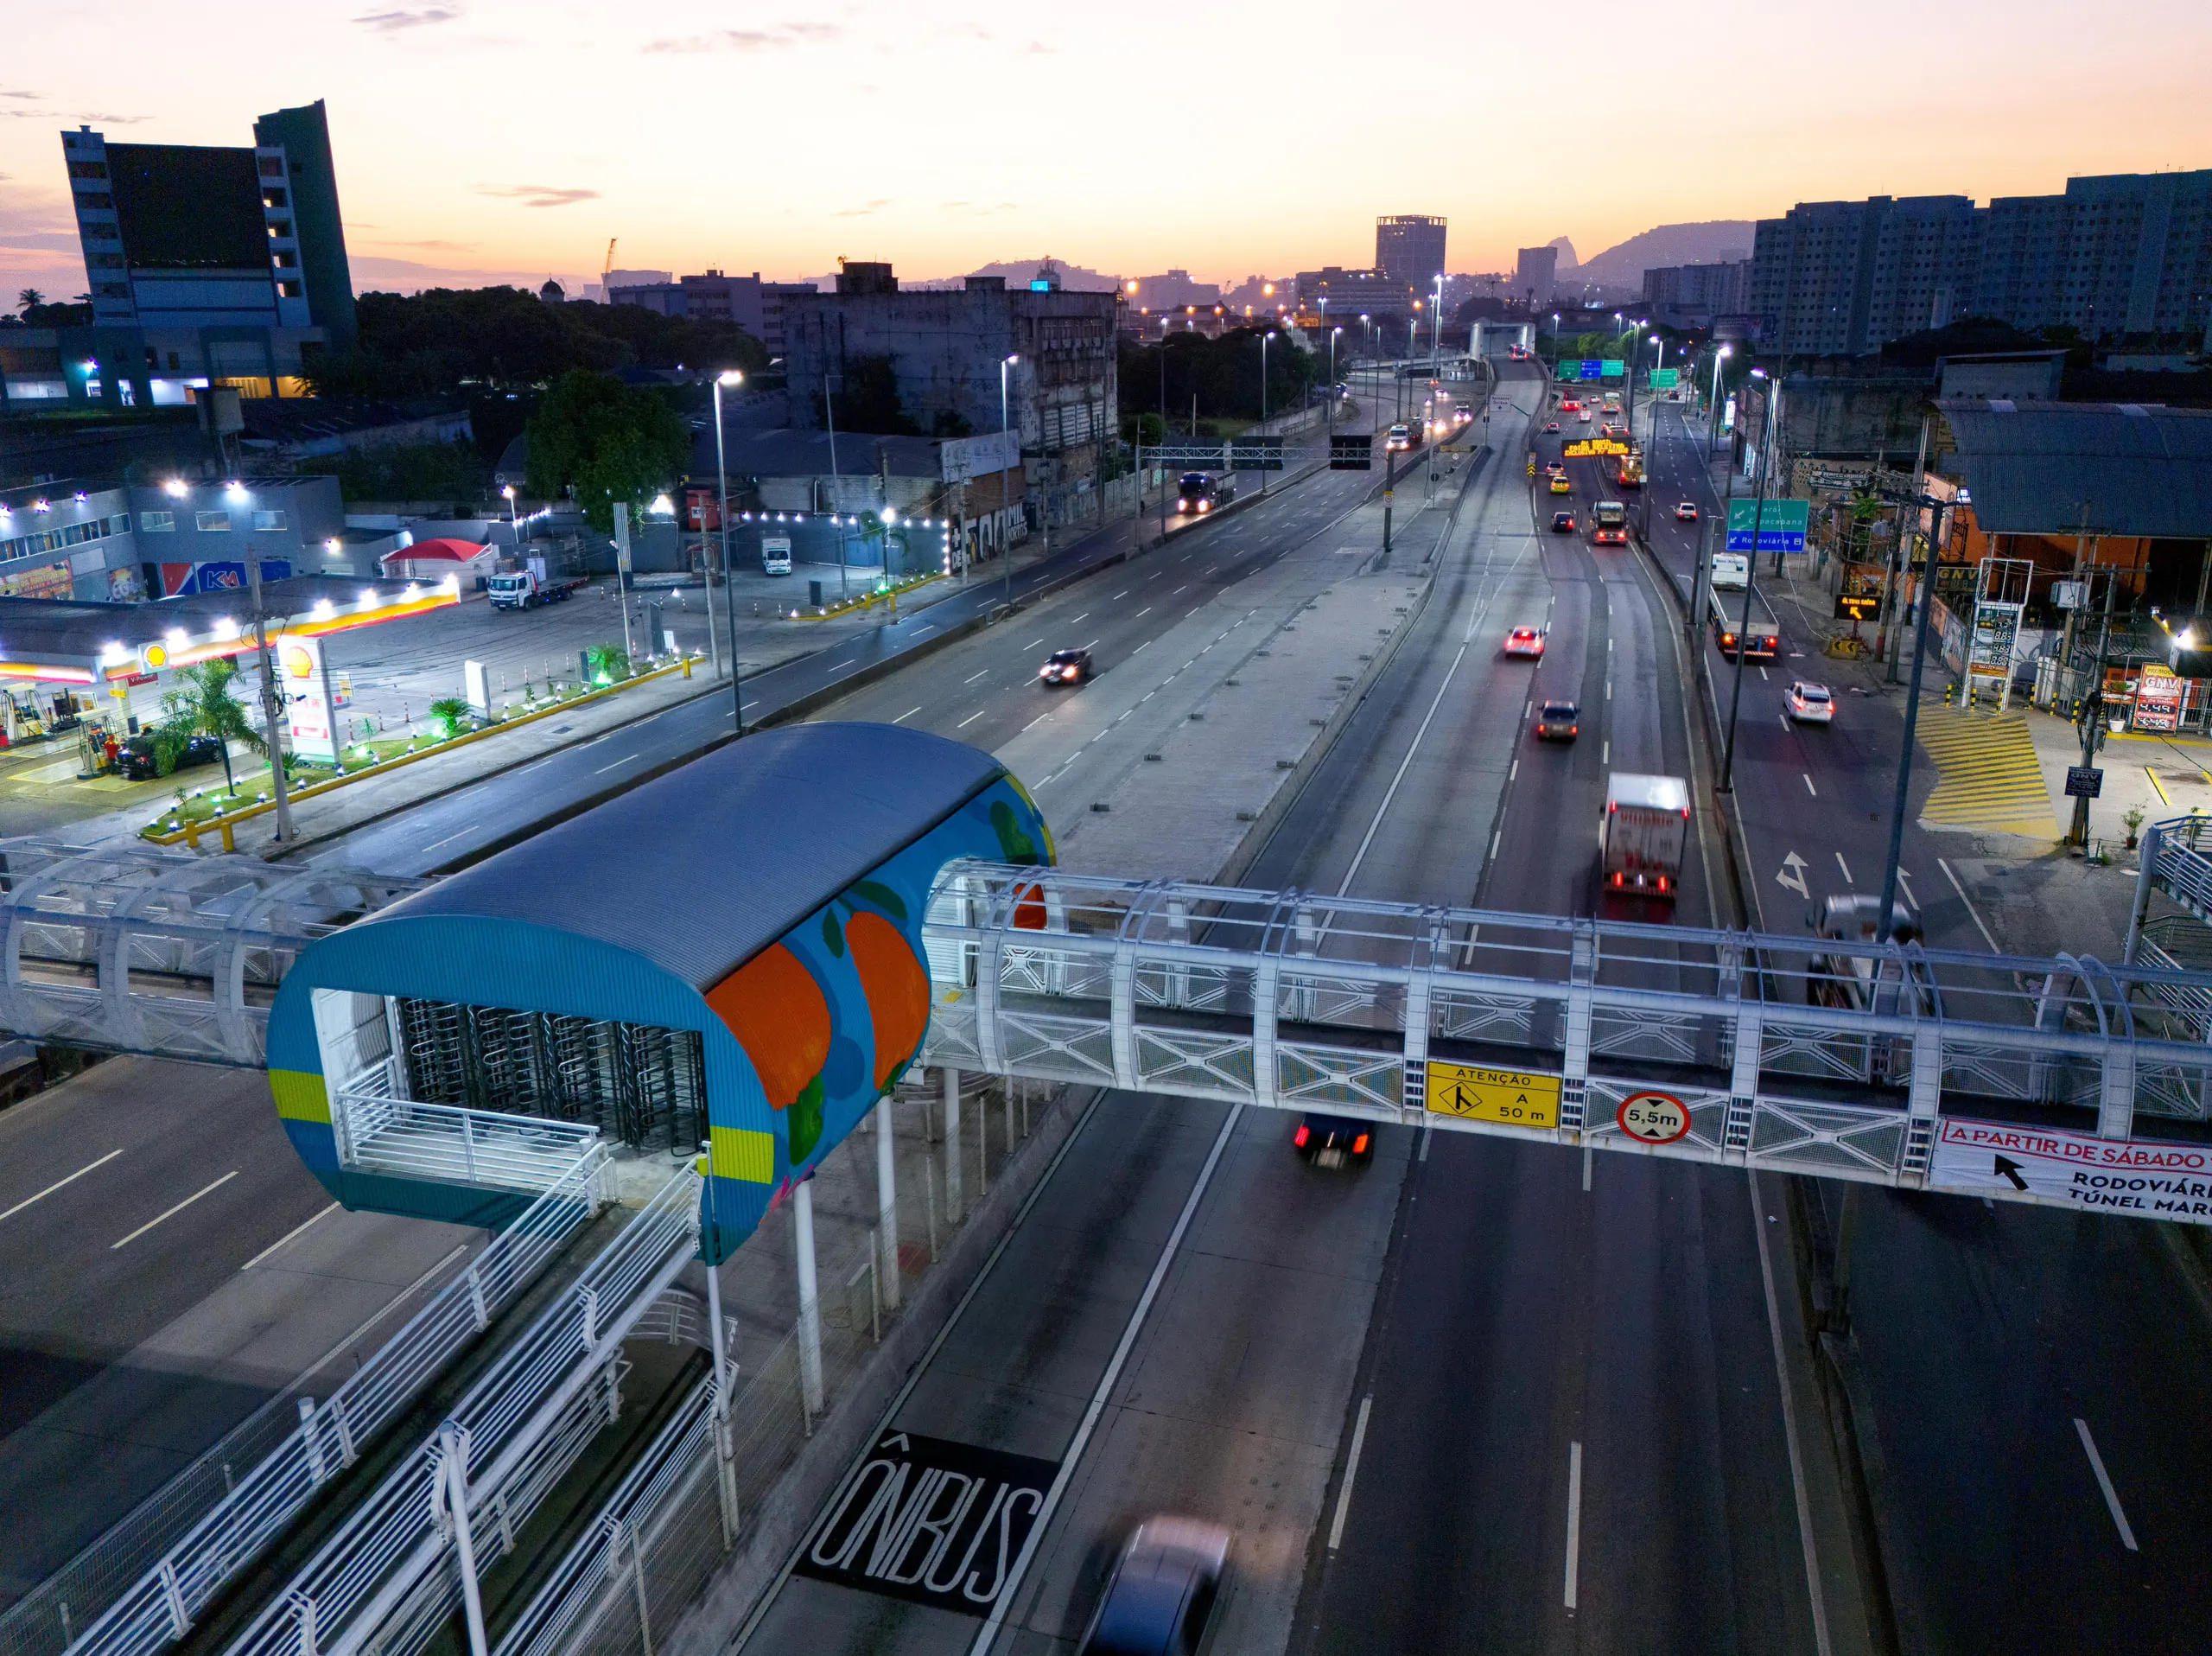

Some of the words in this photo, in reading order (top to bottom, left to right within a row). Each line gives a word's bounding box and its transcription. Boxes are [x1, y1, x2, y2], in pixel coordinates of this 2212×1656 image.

[1938, 569, 1978, 580] GNV
[2145, 677, 2178, 689] GNV
[1456, 1068, 1531, 1086] ATENÇÃO
[1516, 1093, 1529, 1104] A
[1499, 1106, 1522, 1118] 50
[1530, 1111, 1545, 1121] m
[1628, 1109, 1678, 1127] 5,5m
[1950, 1128, 1967, 1141] A
[1973, 1131, 2058, 1155] PARTIR
[2063, 1143, 2099, 1161] DE
[2101, 1146, 2205, 1168] SÁBADO
[2069, 1188, 2146, 1209] TÚNEL
[2153, 1200, 2212, 1216] MAR
[810, 1432, 1043, 1603] ÔNIBUS
